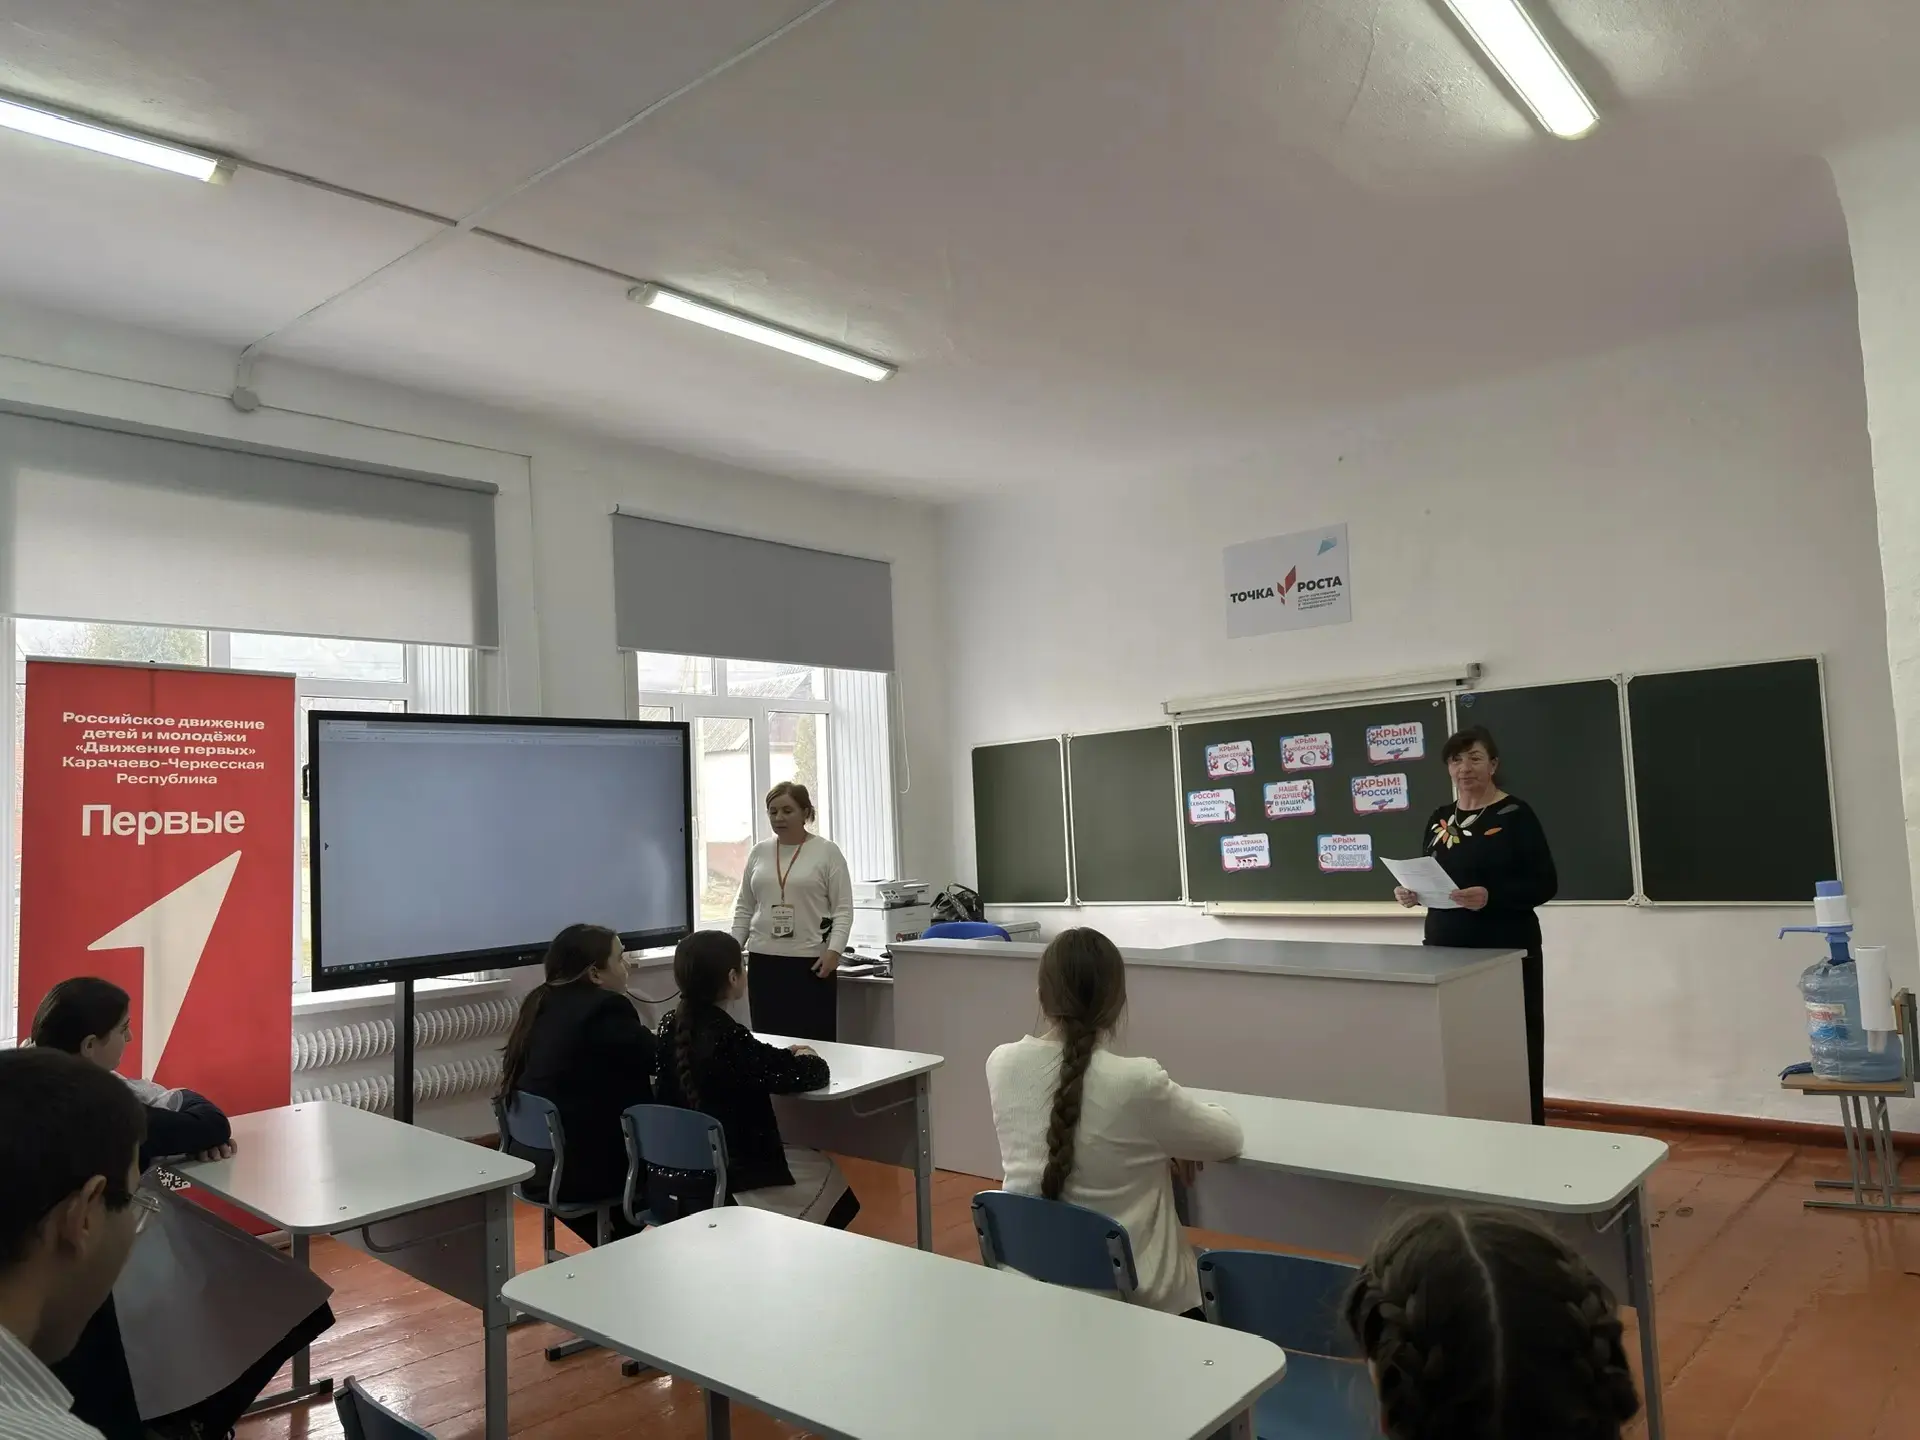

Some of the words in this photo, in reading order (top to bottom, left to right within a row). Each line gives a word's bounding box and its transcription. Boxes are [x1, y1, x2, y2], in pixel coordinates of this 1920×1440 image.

[1230, 587, 1274, 603] ТОЧКА
[1297, 576, 1342, 592] РОСТА
[62, 711, 175, 726] Российское
[178, 717, 265, 730] движение
[82, 728, 138, 740] детей
[141, 731, 152, 740] и
[157, 730, 247, 742] молодёжи
[1376, 726, 1416, 738] КРЫМ!
[1376, 737, 1417, 746] РОССИЯ!
[75, 742, 181, 755] «Движение
[184, 745, 256, 756] первых»
[62, 756, 265, 770] Карачаево-Черкесская
[116, 773, 217, 786] Республика
[1360, 777, 1400, 788] КРЫМ!
[1279, 784, 1298, 792] НАШЕ
[1361, 787, 1402, 797] РОССИЯ!
[82, 804, 245, 845] Первые
